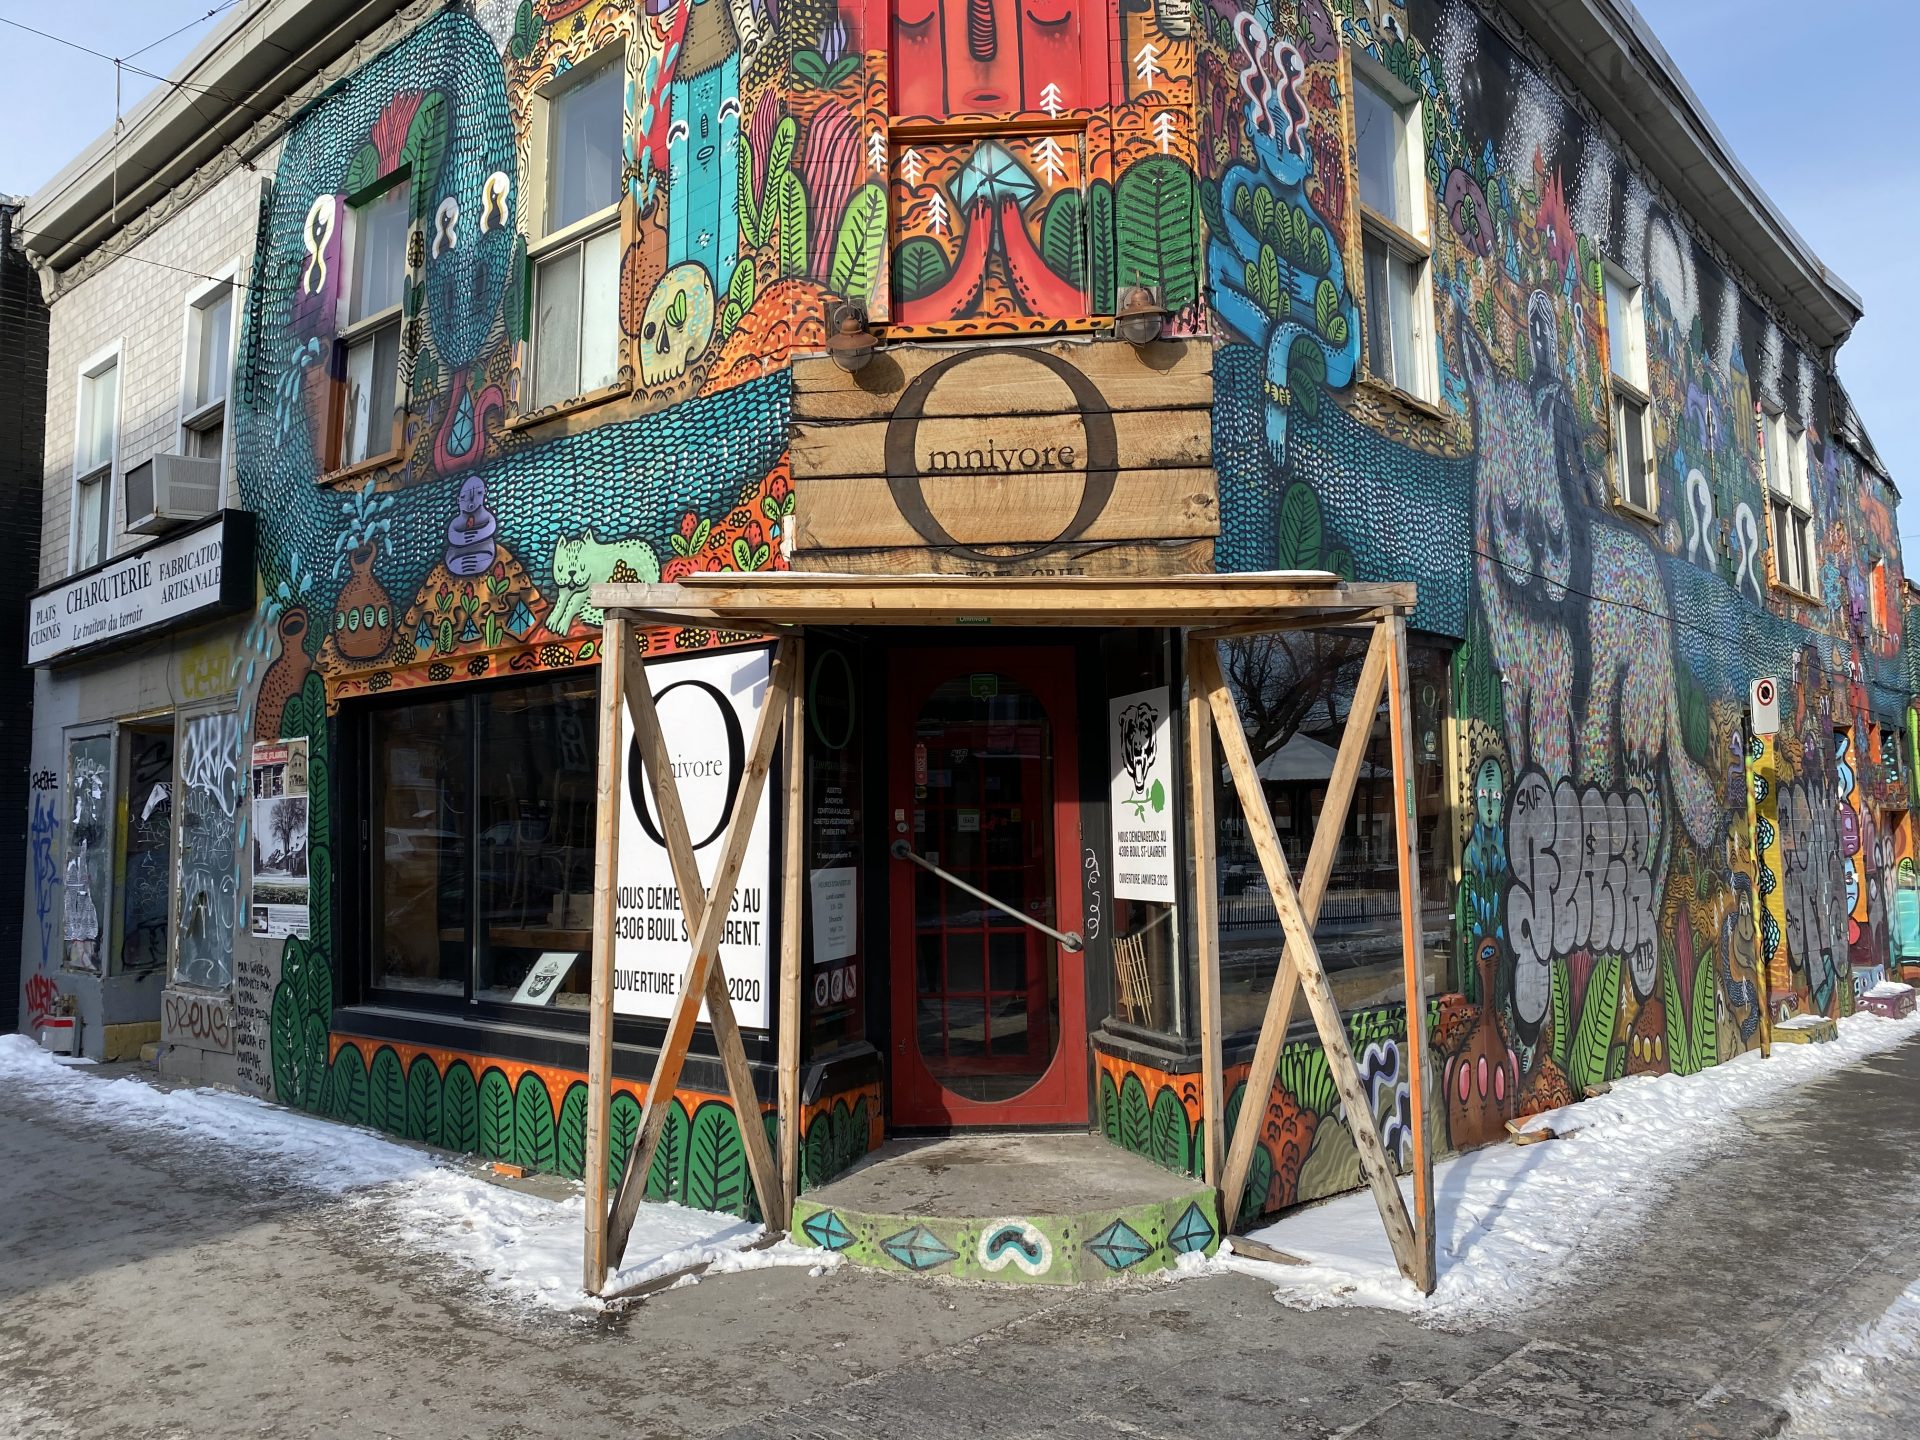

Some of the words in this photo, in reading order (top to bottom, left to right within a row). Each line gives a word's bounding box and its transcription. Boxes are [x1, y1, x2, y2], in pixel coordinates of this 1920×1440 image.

[159, 541, 222, 581] FABRICATION
[66, 561, 152, 615] CHARCUTERIE
[161, 566, 221, 604] ARTISANALE
[36, 604, 56, 626] PLATS
[73, 624, 82, 640] Le
[83, 618, 107, 638] traiteur
[108, 613, 118, 632] du
[120, 604, 143, 628] terroir
[742, 888, 761, 913] AU
[615, 916, 644, 940] 4306
[647, 917, 678, 942] BOUL
[613, 969, 675, 995] OUVERTURE
[728, 977, 760, 1003] 2020
